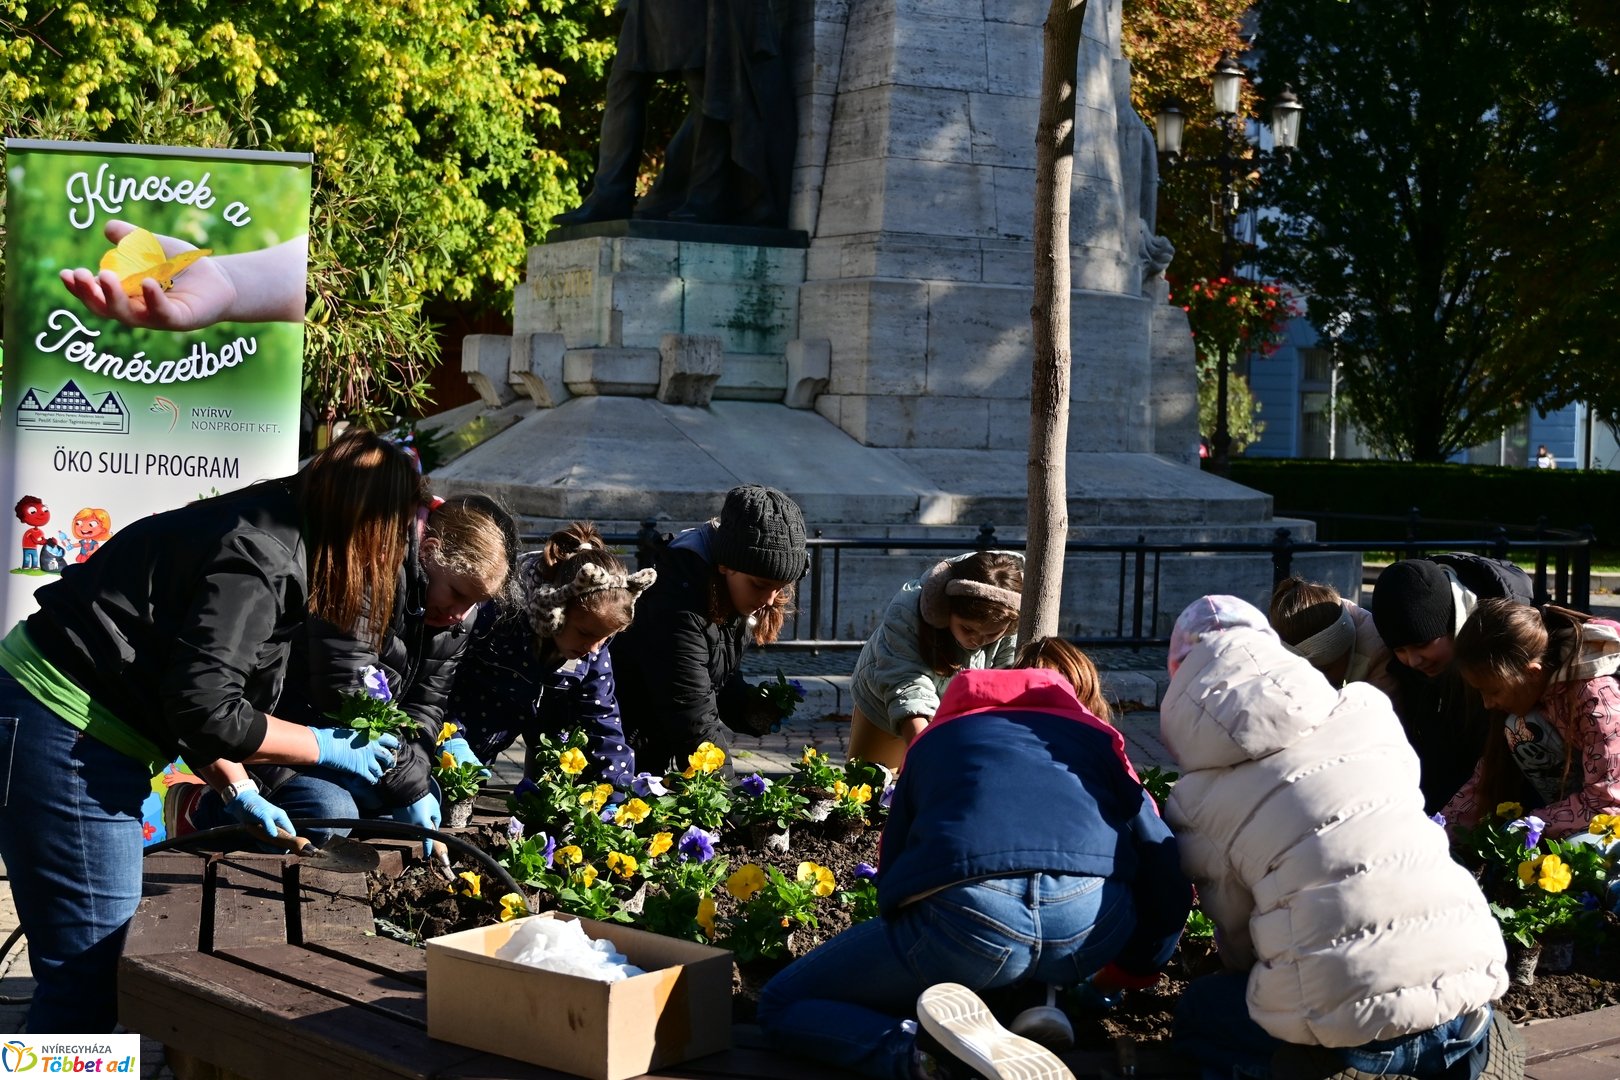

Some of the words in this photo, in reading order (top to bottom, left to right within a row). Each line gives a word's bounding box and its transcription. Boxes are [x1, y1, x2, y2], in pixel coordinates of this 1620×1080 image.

[66, 163, 216, 230] Kincsek
[223, 201, 251, 227] a
[35, 309, 257, 384] Természetben
[192, 407, 232, 418] NYÍRVV
[192, 421, 255, 432] NONPROFIT
[258, 424, 281, 433] KFT.
[54, 446, 92, 472] ÖKO
[98, 452, 139, 474] SULI
[145, 453, 239, 478] PROGRAM
